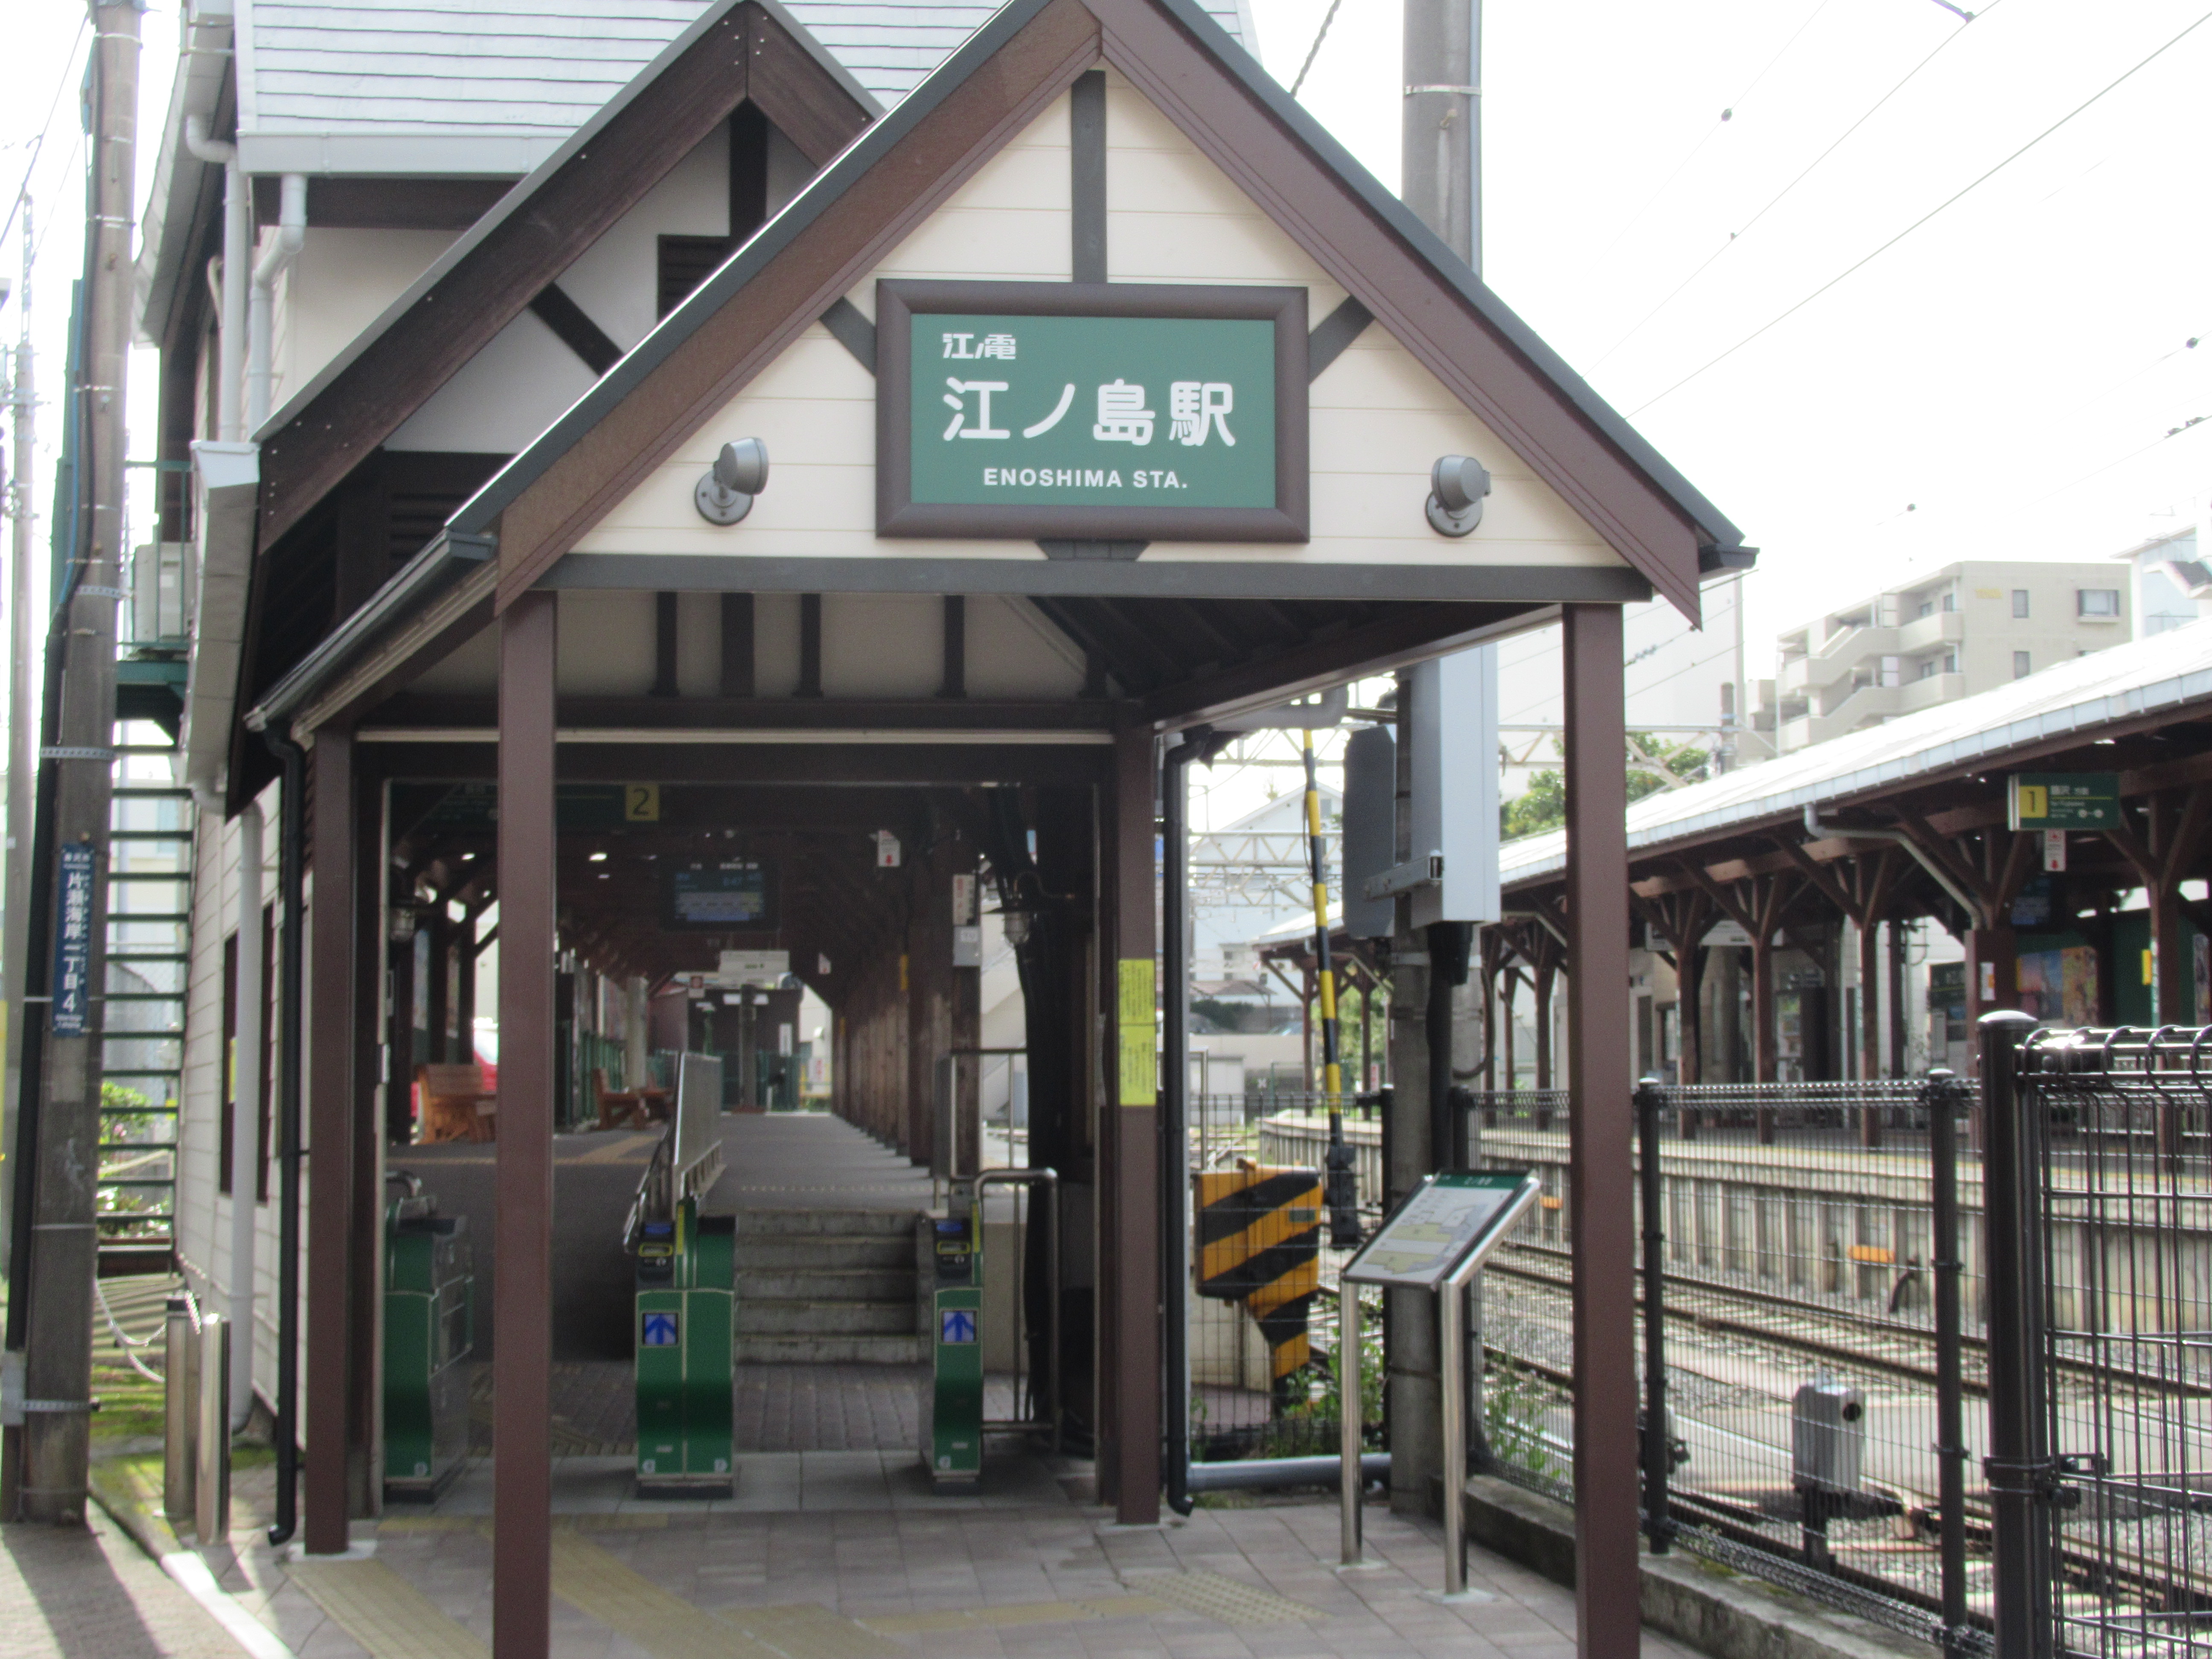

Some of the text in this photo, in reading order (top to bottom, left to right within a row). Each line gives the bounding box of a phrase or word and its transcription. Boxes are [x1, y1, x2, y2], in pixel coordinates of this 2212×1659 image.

[942, 332, 1016, 360] 江ノ電
[943, 377, 1236, 447] 江ノ島駅
[983, 468, 1188, 489] ENOSHIMA STA.
[633, 788, 649, 815] 2
[2029, 791, 2036, 812] 1
